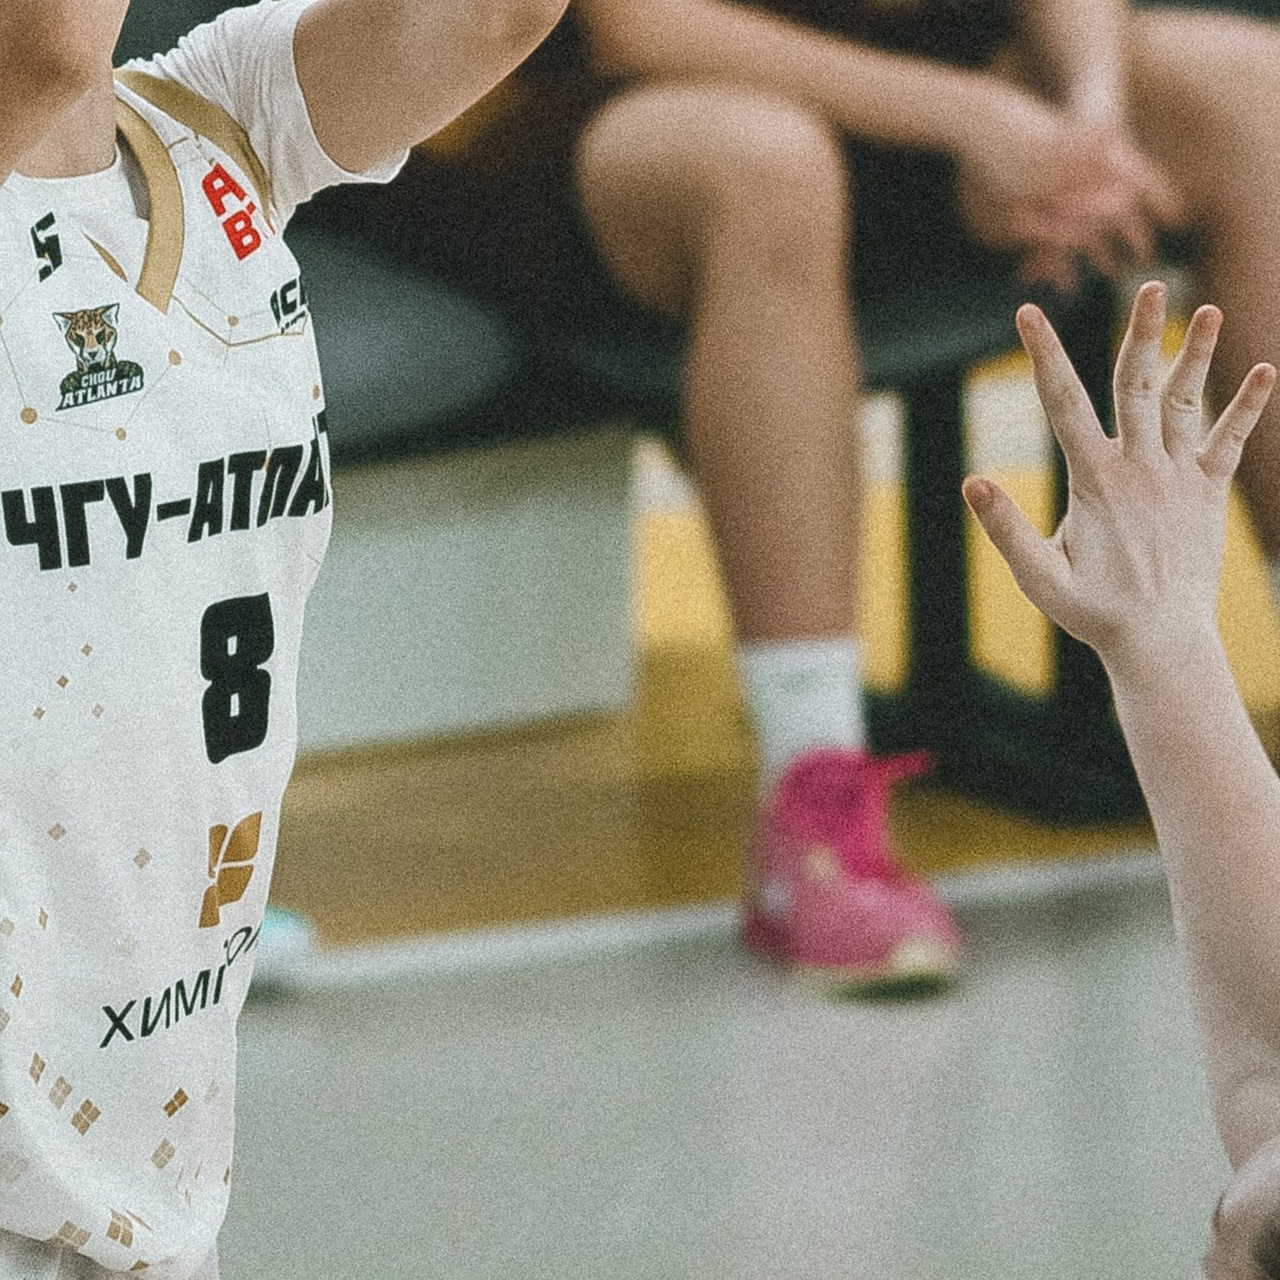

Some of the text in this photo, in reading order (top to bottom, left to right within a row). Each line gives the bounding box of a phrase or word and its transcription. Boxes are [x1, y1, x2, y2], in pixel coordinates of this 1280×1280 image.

[61, 374, 142, 408] ATLANTA
[1, 438, 329, 571] ЧГУ-АТЛА
[200, 591, 275, 765] 8
